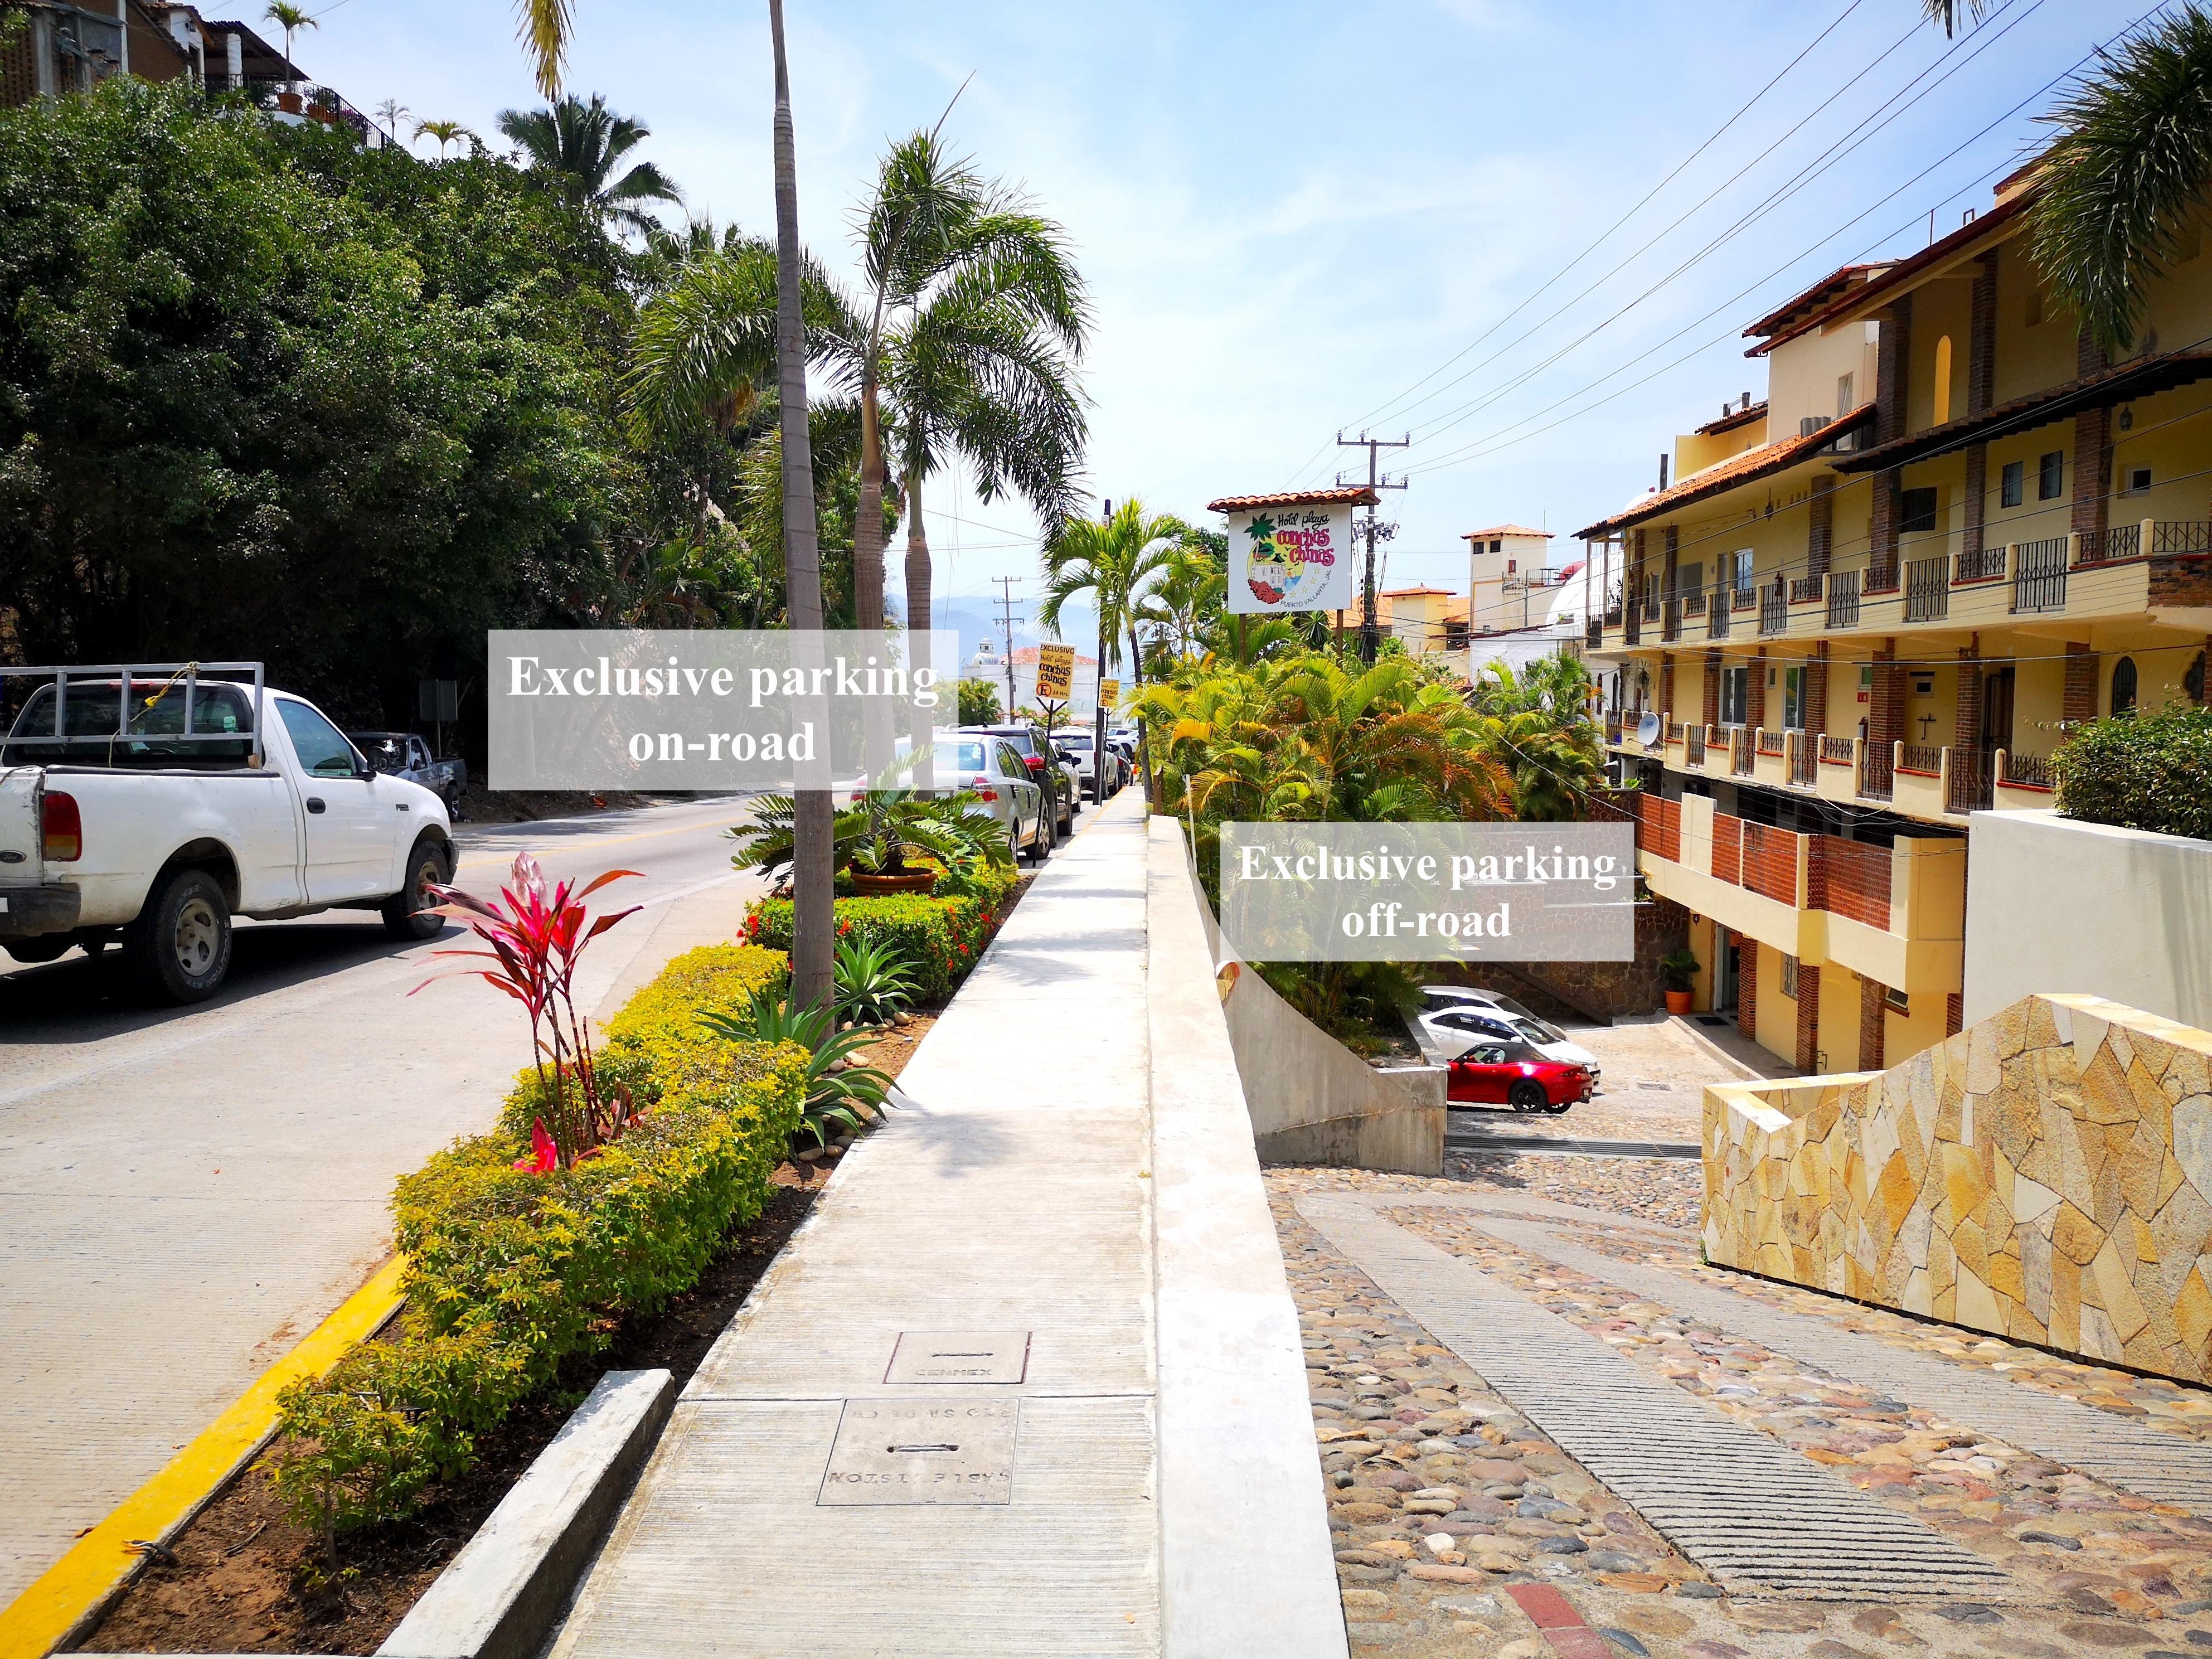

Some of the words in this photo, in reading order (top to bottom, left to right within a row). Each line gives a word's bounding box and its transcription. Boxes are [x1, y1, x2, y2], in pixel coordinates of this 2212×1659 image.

[1278, 512, 1299, 527] Hotel
[1302, 510, 1330, 530] playa
[1277, 527, 1330, 547] conchas
[1289, 545, 1335, 566] chinas
[1040, 644, 1075, 654] EXCLUSIVO
[1039, 663, 1071, 677] conchas
[1040, 672, 1068, 687] chinas
[1040, 685, 1048, 696] E
